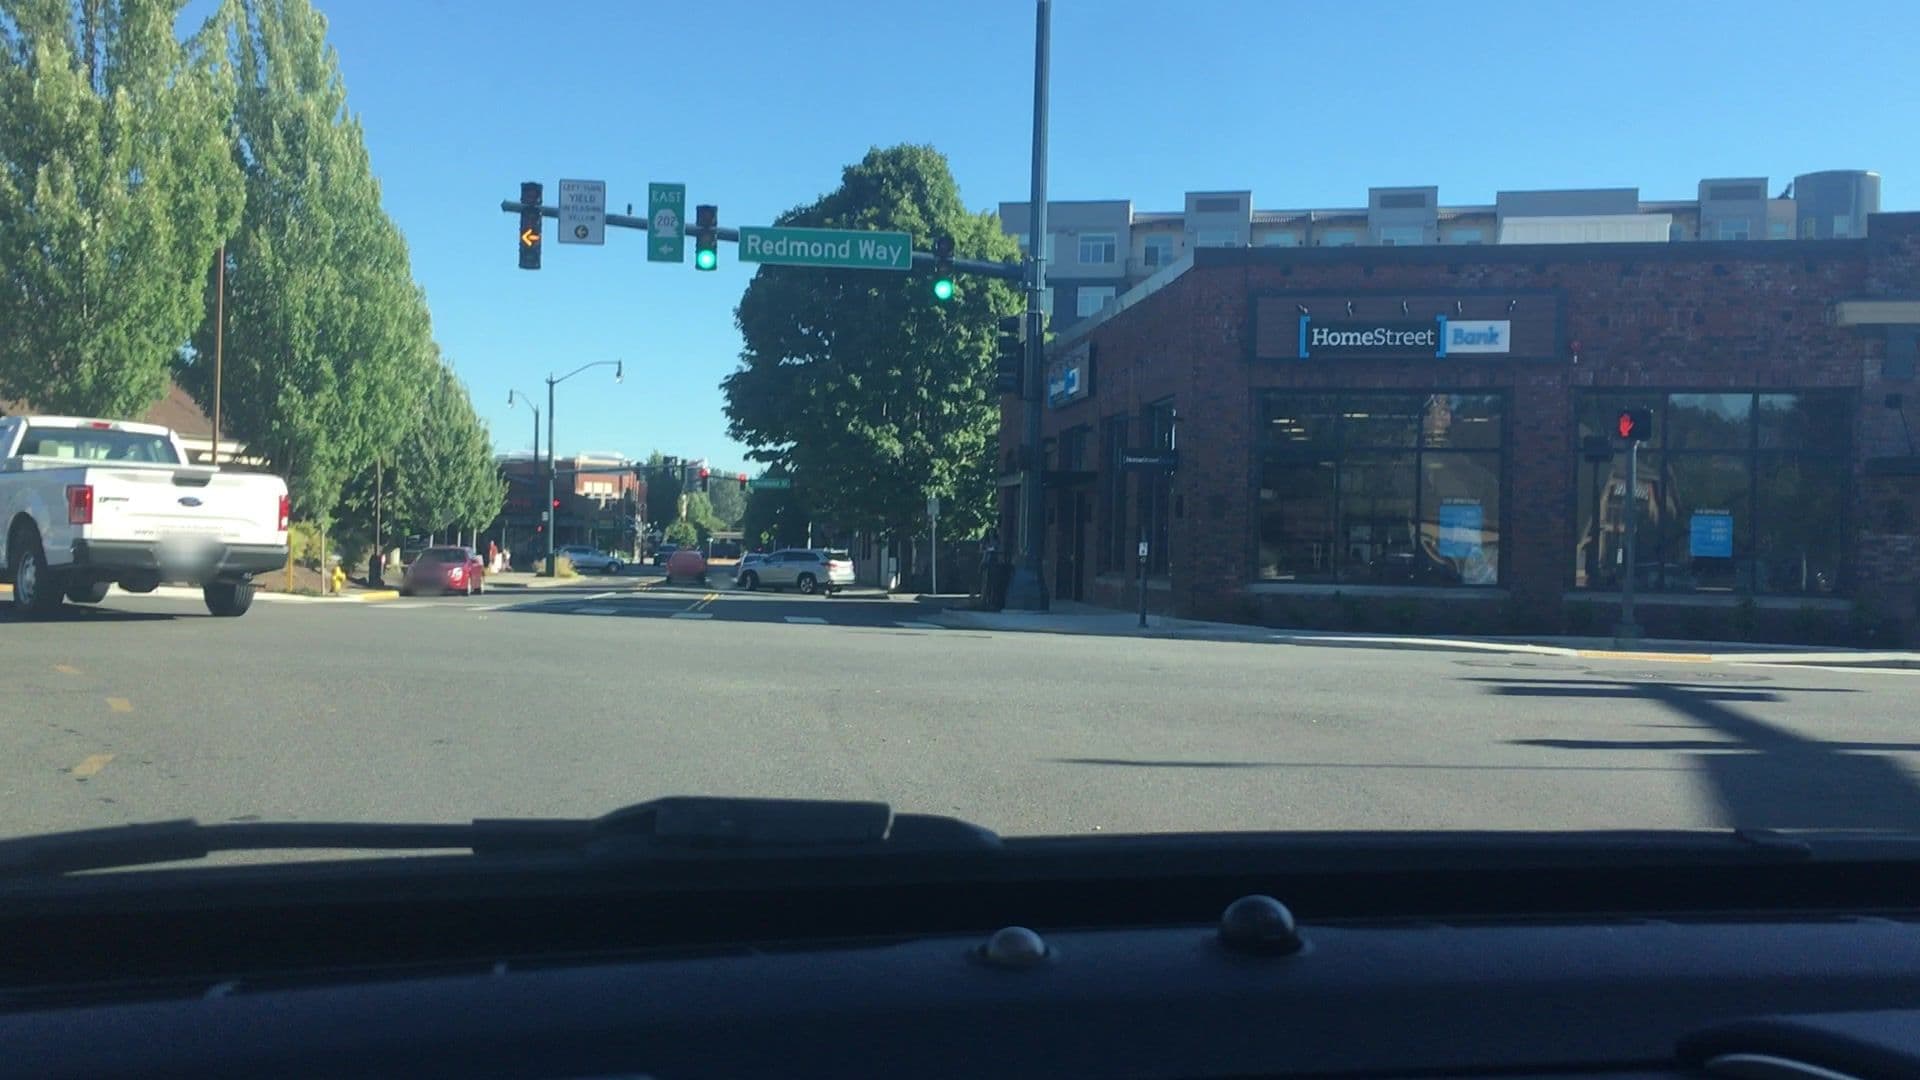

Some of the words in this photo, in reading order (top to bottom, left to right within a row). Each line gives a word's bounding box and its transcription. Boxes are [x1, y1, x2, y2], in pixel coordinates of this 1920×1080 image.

[569, 193, 596, 203] YIELD
[652, 191, 681, 202] EAST
[657, 215, 677, 226] 202
[747, 234, 850, 259] Redmond
[859, 239, 903, 266] Way
[1312, 327, 1435, 346] HomeStreet
[1452, 327, 1500, 345] Bank
